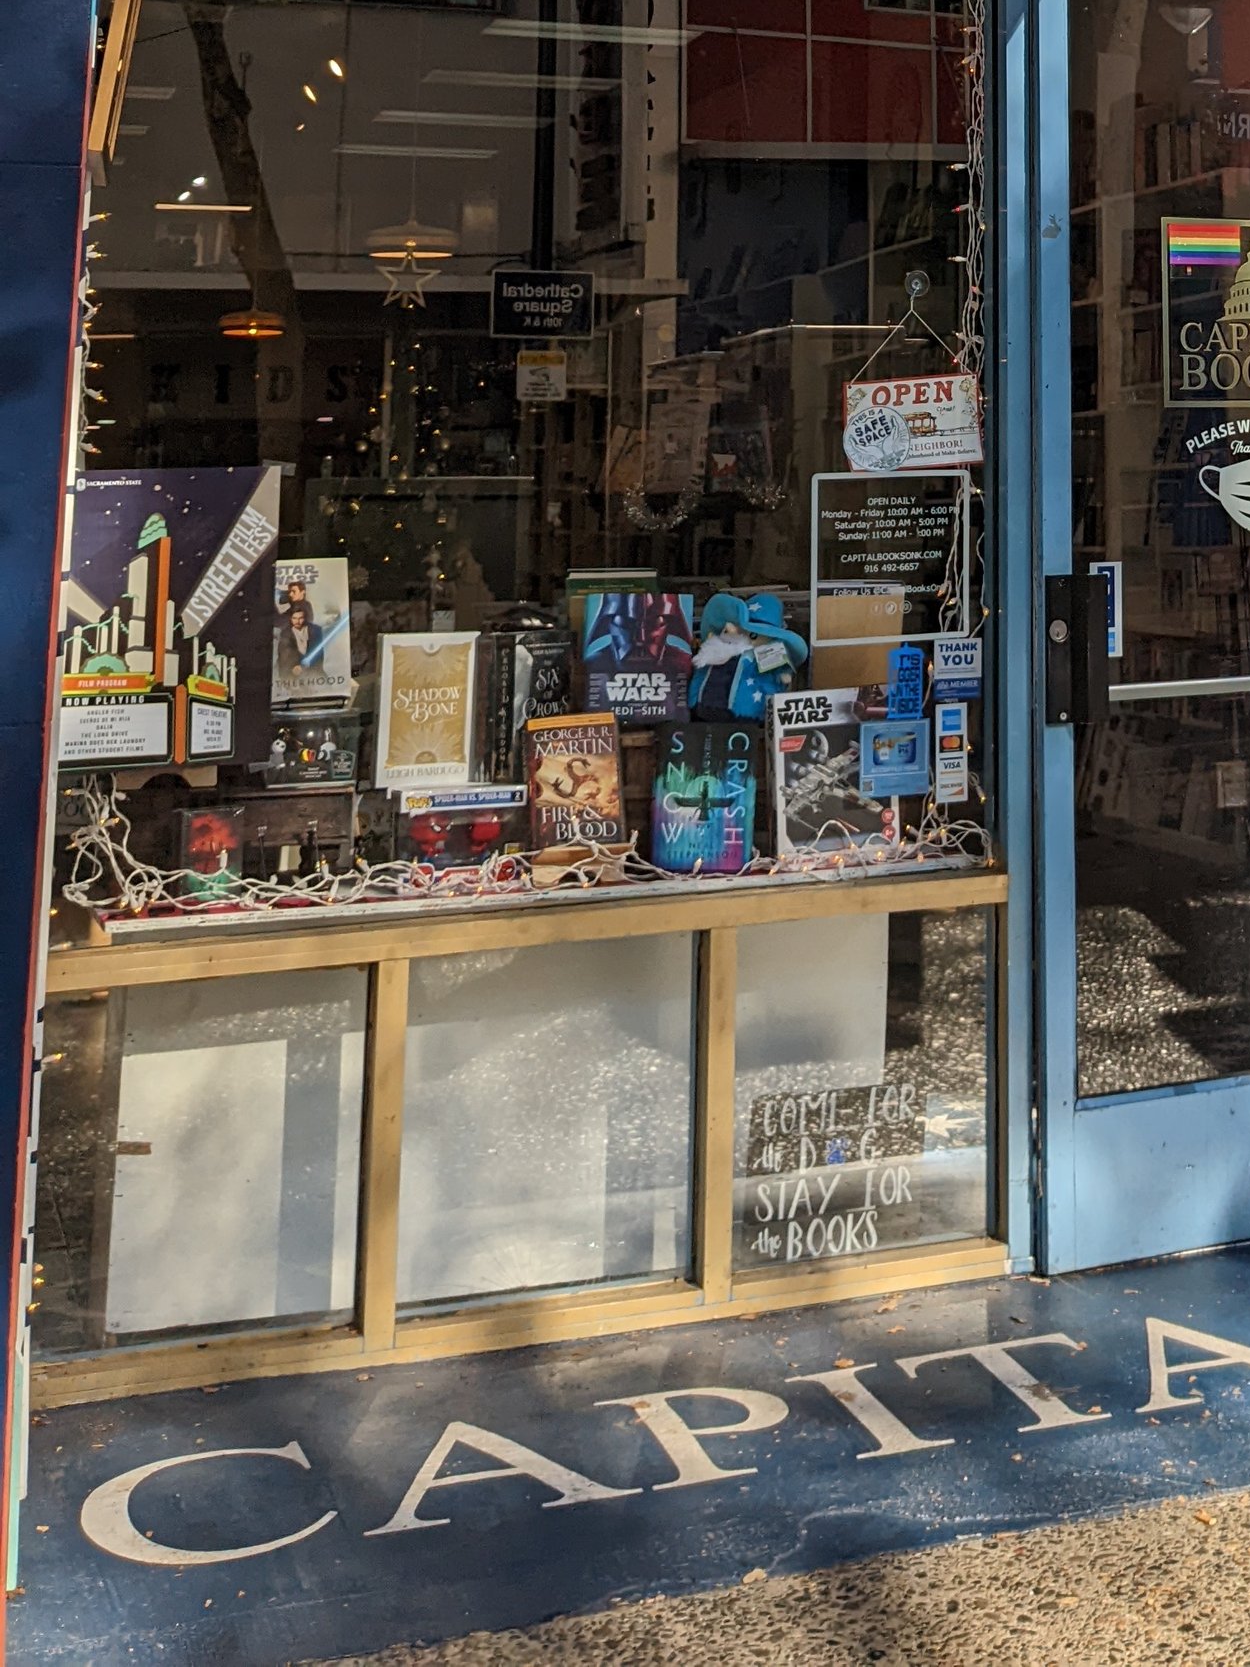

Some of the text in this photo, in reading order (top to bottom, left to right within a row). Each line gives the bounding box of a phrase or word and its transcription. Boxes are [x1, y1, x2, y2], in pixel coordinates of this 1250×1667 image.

[871, 380, 954, 407] OPEN
[855, 415, 888, 437] SAFE
[858, 426, 892, 447] SPACE
[1185, 424, 1236, 454] PLEASE
[867, 496, 917, 506] OPEN DAILY
[821, 510, 852, 519] Monday
[860, 509, 884, 518] Friday
[887, 508, 908, 516] 10:00
[910, 507, 923, 515] AM
[930, 507, 947, 515] 6:00
[230, 504, 266, 548] FILM
[875, 519, 896, 528] 10:00
[898, 519, 911, 527] AM
[937, 517, 949, 525] PM
[243, 516, 278, 559] FEST
[894, 530, 907, 538] AM
[932, 528, 945, 536] PM
[840, 550, 942, 563] CAPITALBOOKSONK.COM
[864, 563, 920, 573] 916 492-6657
[190, 541, 252, 618] STREET
[938, 642, 978, 653] THANK
[942, 653, 974, 666] YOU
[606, 672, 671, 687] STAR
[66, 695, 145, 707] NOW PLAYING
[393, 685, 463, 710] SHADOW
[607, 686, 671, 702] WARS
[641, 704, 666, 716] SITH
[777, 695, 832, 712] STAR
[410, 701, 458, 724] BONE
[777, 709, 832, 726] WARS
[533, 727, 587, 743] GEORGE
[534, 738, 614, 759] MARTIN
[943, 761, 962, 770] VISA
[724, 732, 750, 844] CRASH
[581, 803, 601, 820] &
[556, 821, 617, 840] BLOOD
[868, 1084, 917, 1129] FOR
[752, 1147, 784, 1173] the
[755, 1166, 914, 1223] STAY FOR
[751, 1210, 879, 1262] the BOOKS
